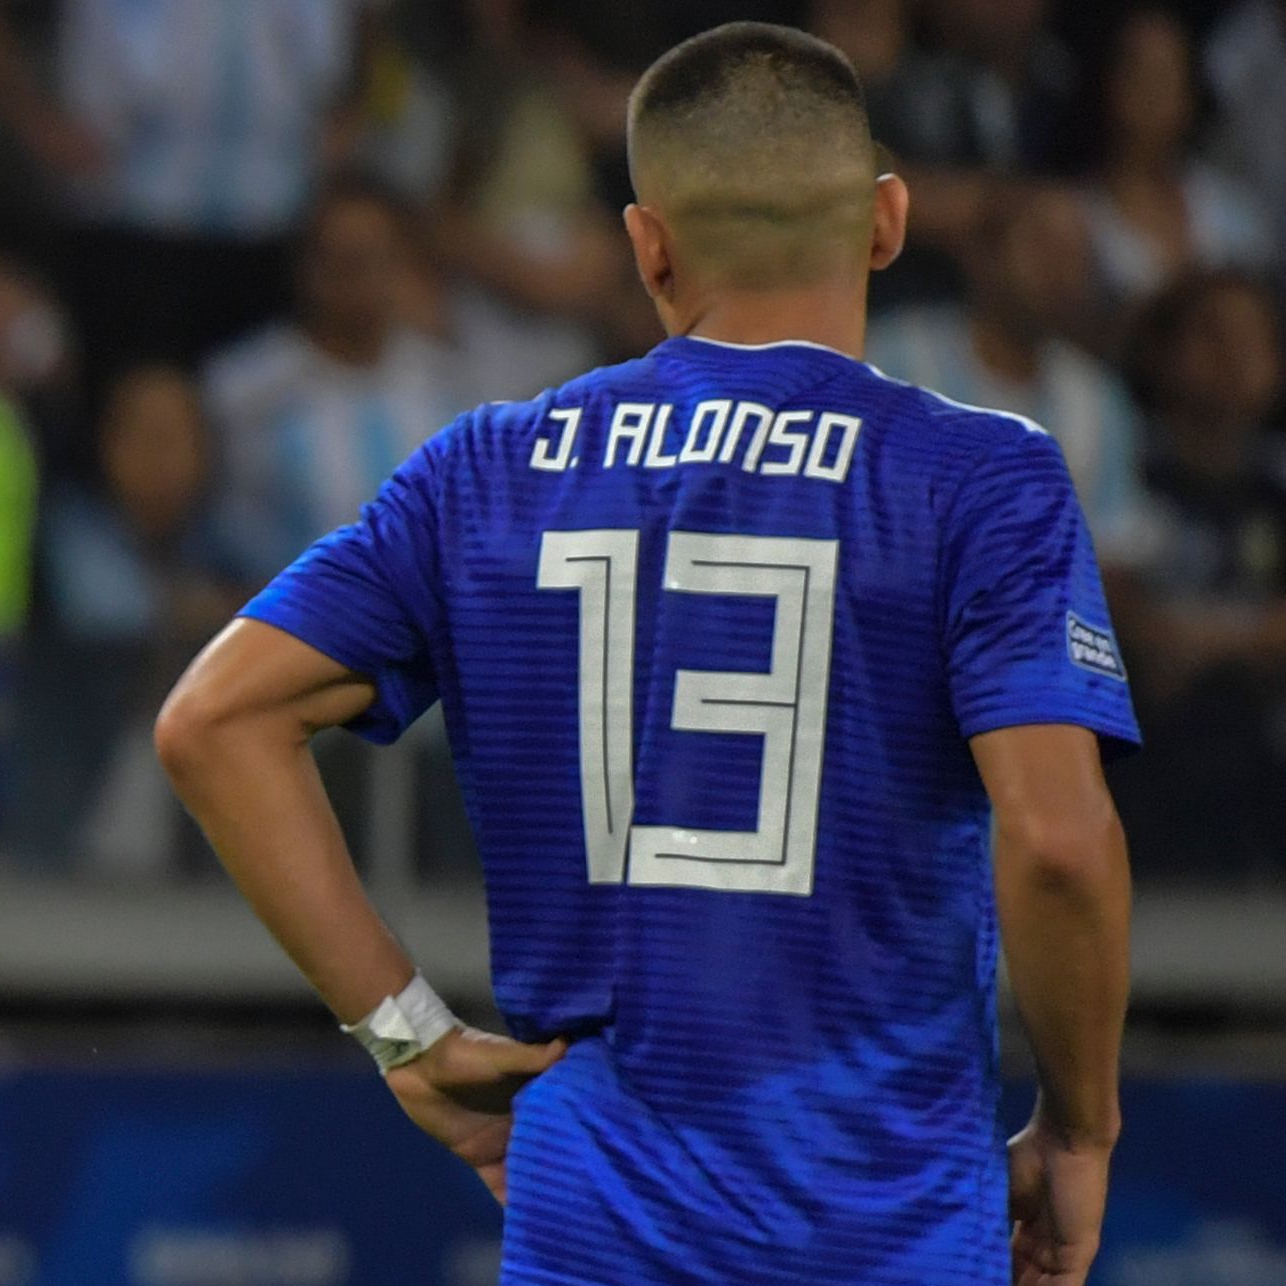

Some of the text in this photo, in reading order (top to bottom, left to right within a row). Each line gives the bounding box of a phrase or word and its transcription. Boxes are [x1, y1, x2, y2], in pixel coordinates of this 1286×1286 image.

[529, 399, 863, 483] J. ALONSO
[536, 529, 840, 896] 13
